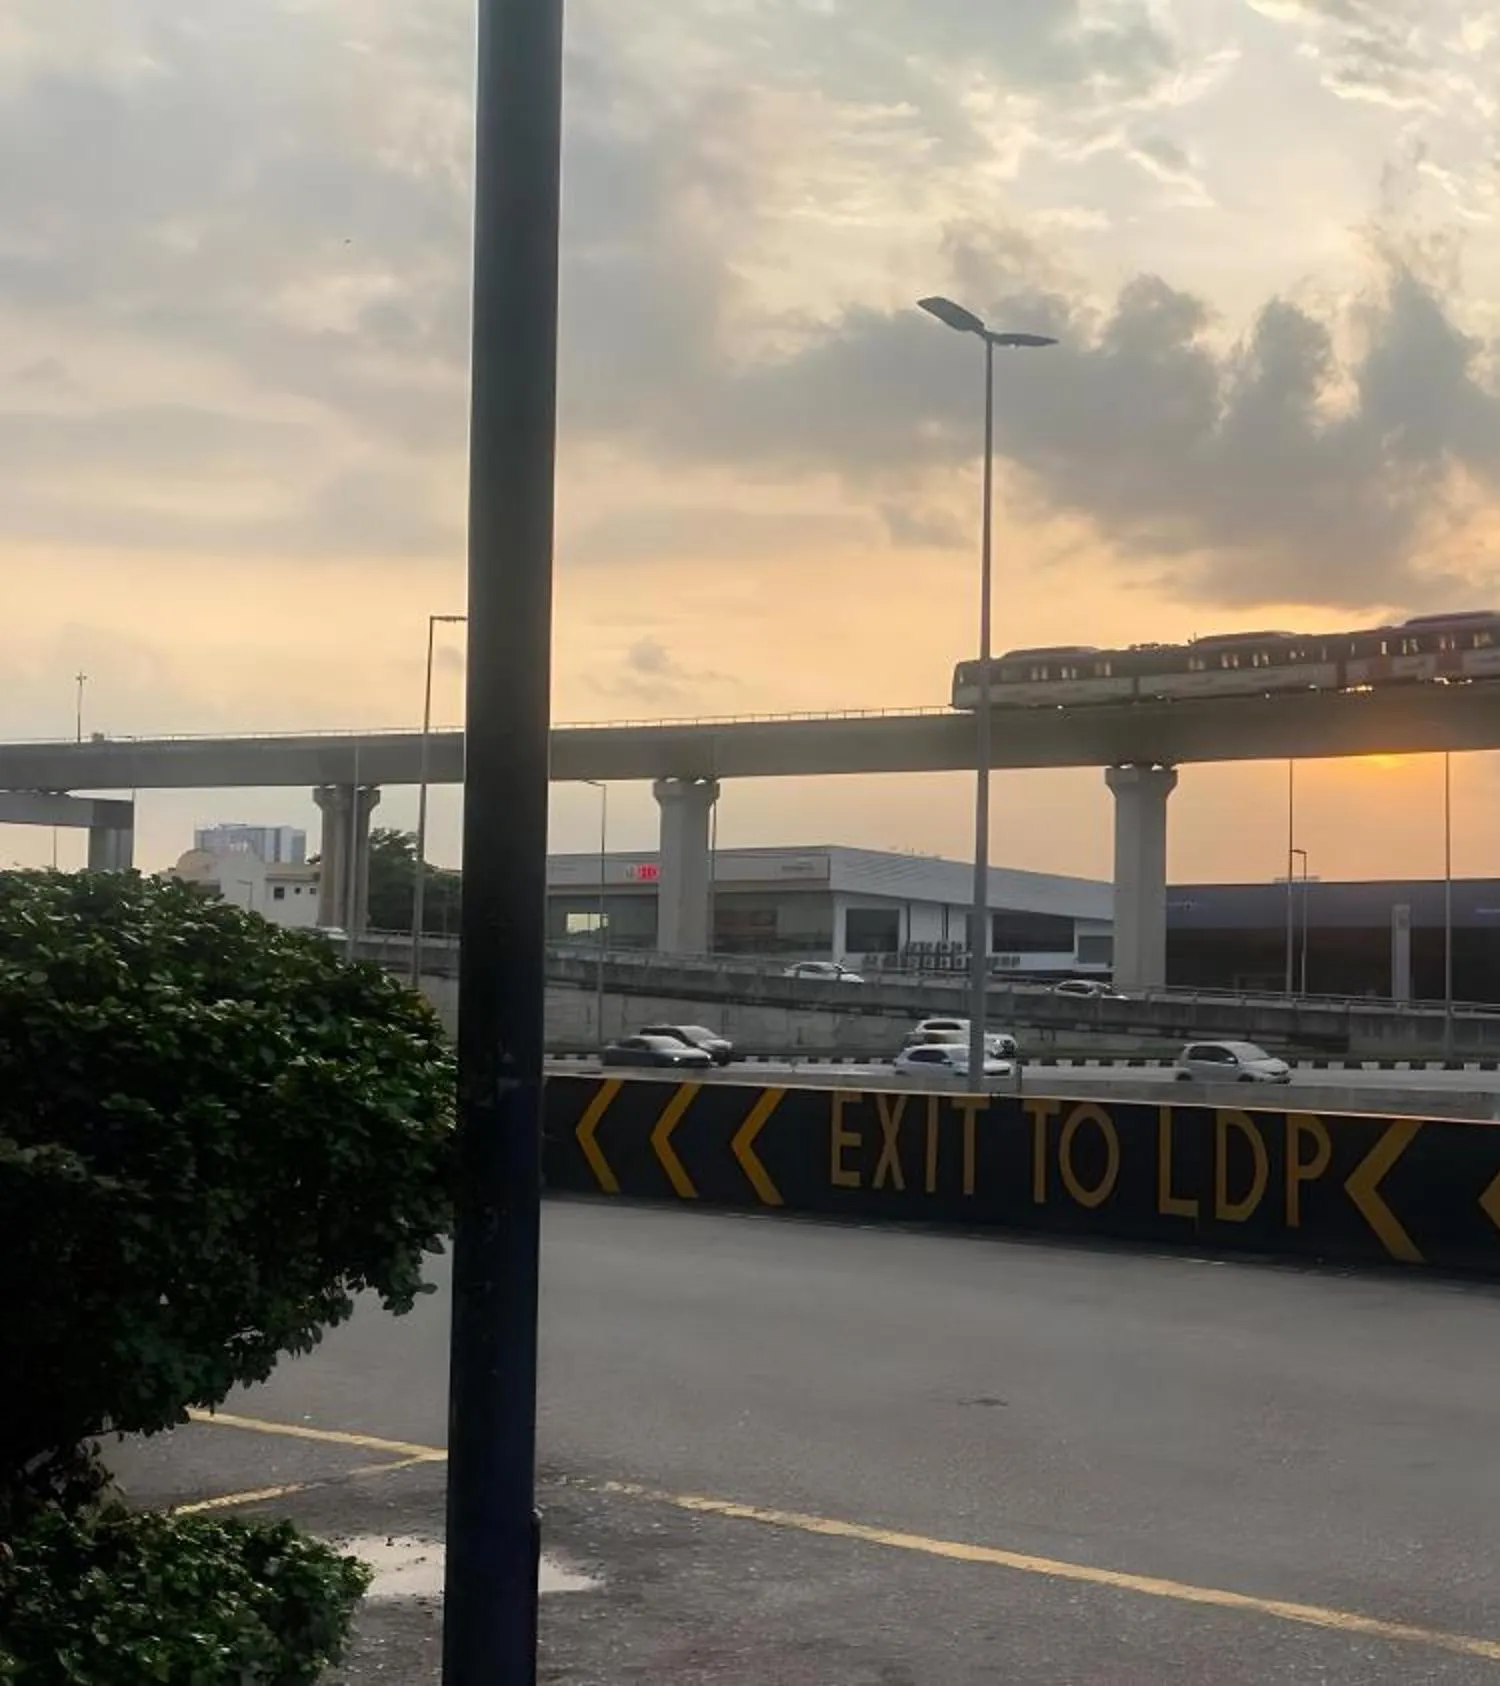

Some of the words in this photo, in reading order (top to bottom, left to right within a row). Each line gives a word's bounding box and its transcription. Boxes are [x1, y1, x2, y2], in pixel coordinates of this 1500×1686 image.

[830, 1089, 990, 1196] EXIT
[1023, 1098, 1120, 1209] TO
[1158, 1105, 1332, 1227] LDP
